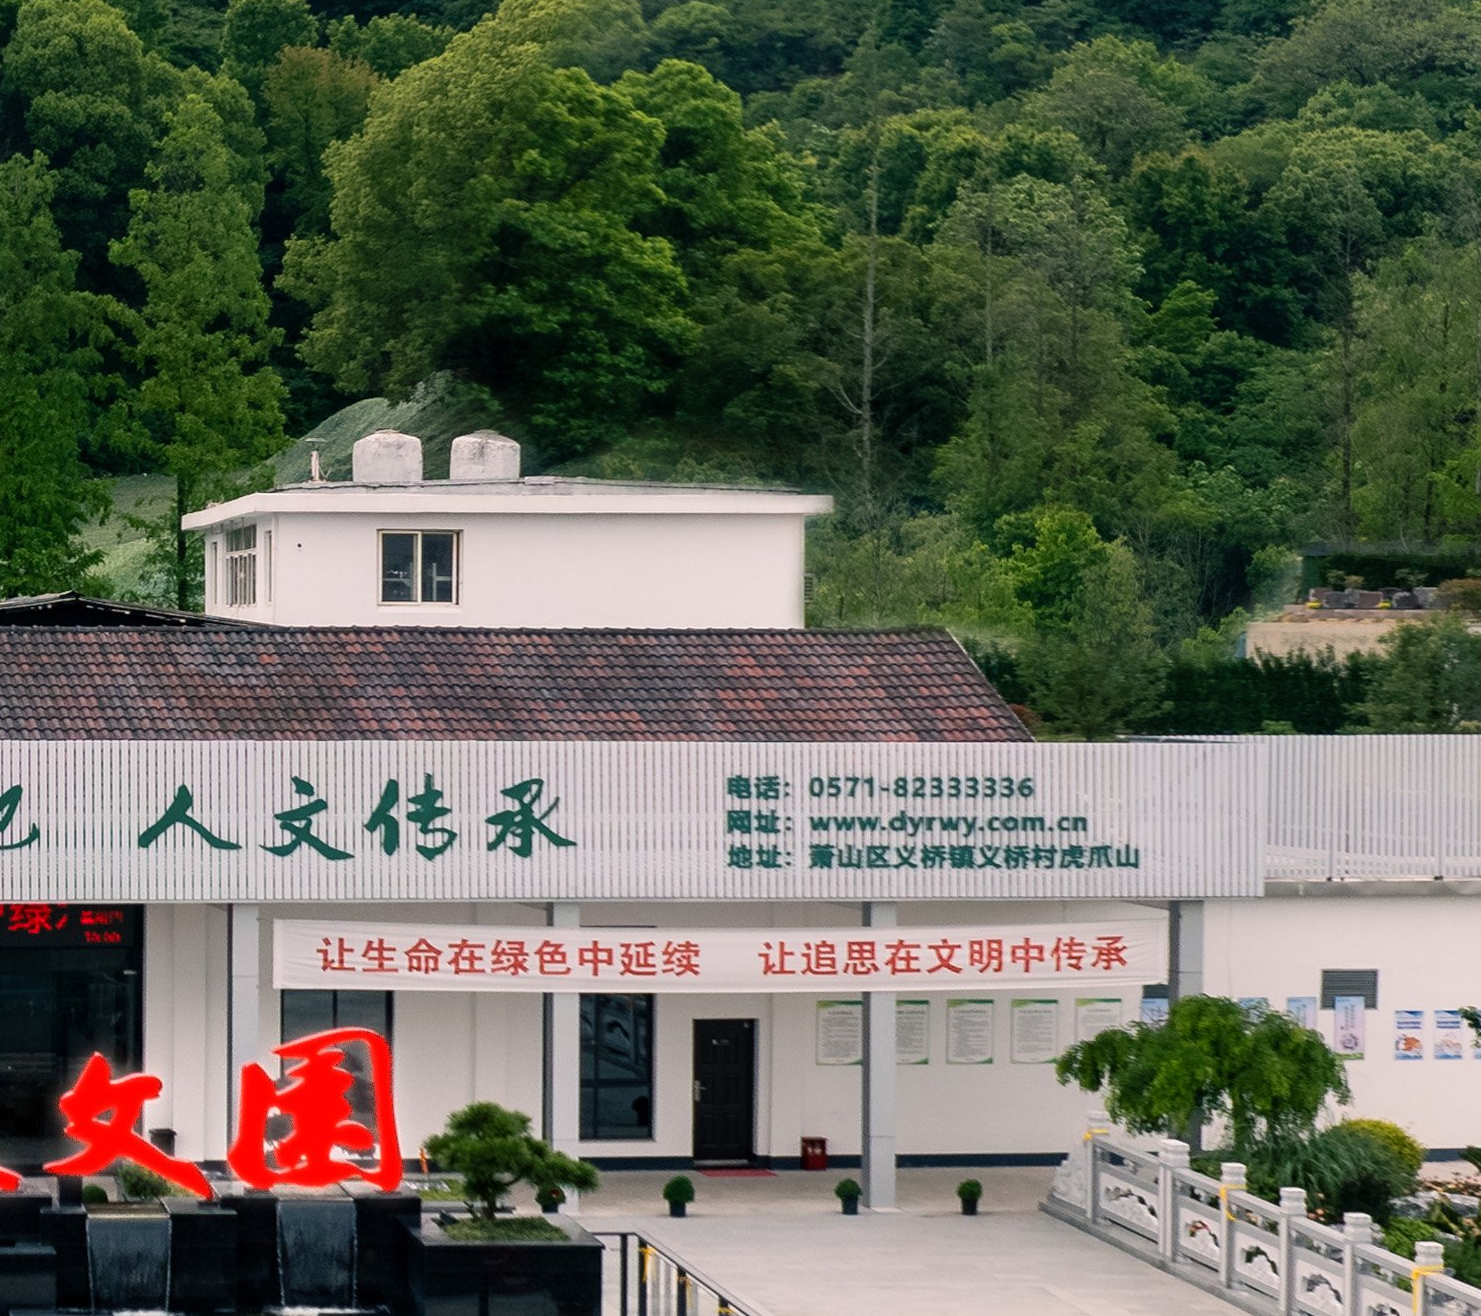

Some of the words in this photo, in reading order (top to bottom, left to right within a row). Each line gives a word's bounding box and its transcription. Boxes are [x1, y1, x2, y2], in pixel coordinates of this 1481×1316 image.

[137, 775, 577, 861] 人文传承
[317, 937, 702, 977] 让生命在绿色中延续
[758, 935, 1129, 976] 让追思在文明中传承
